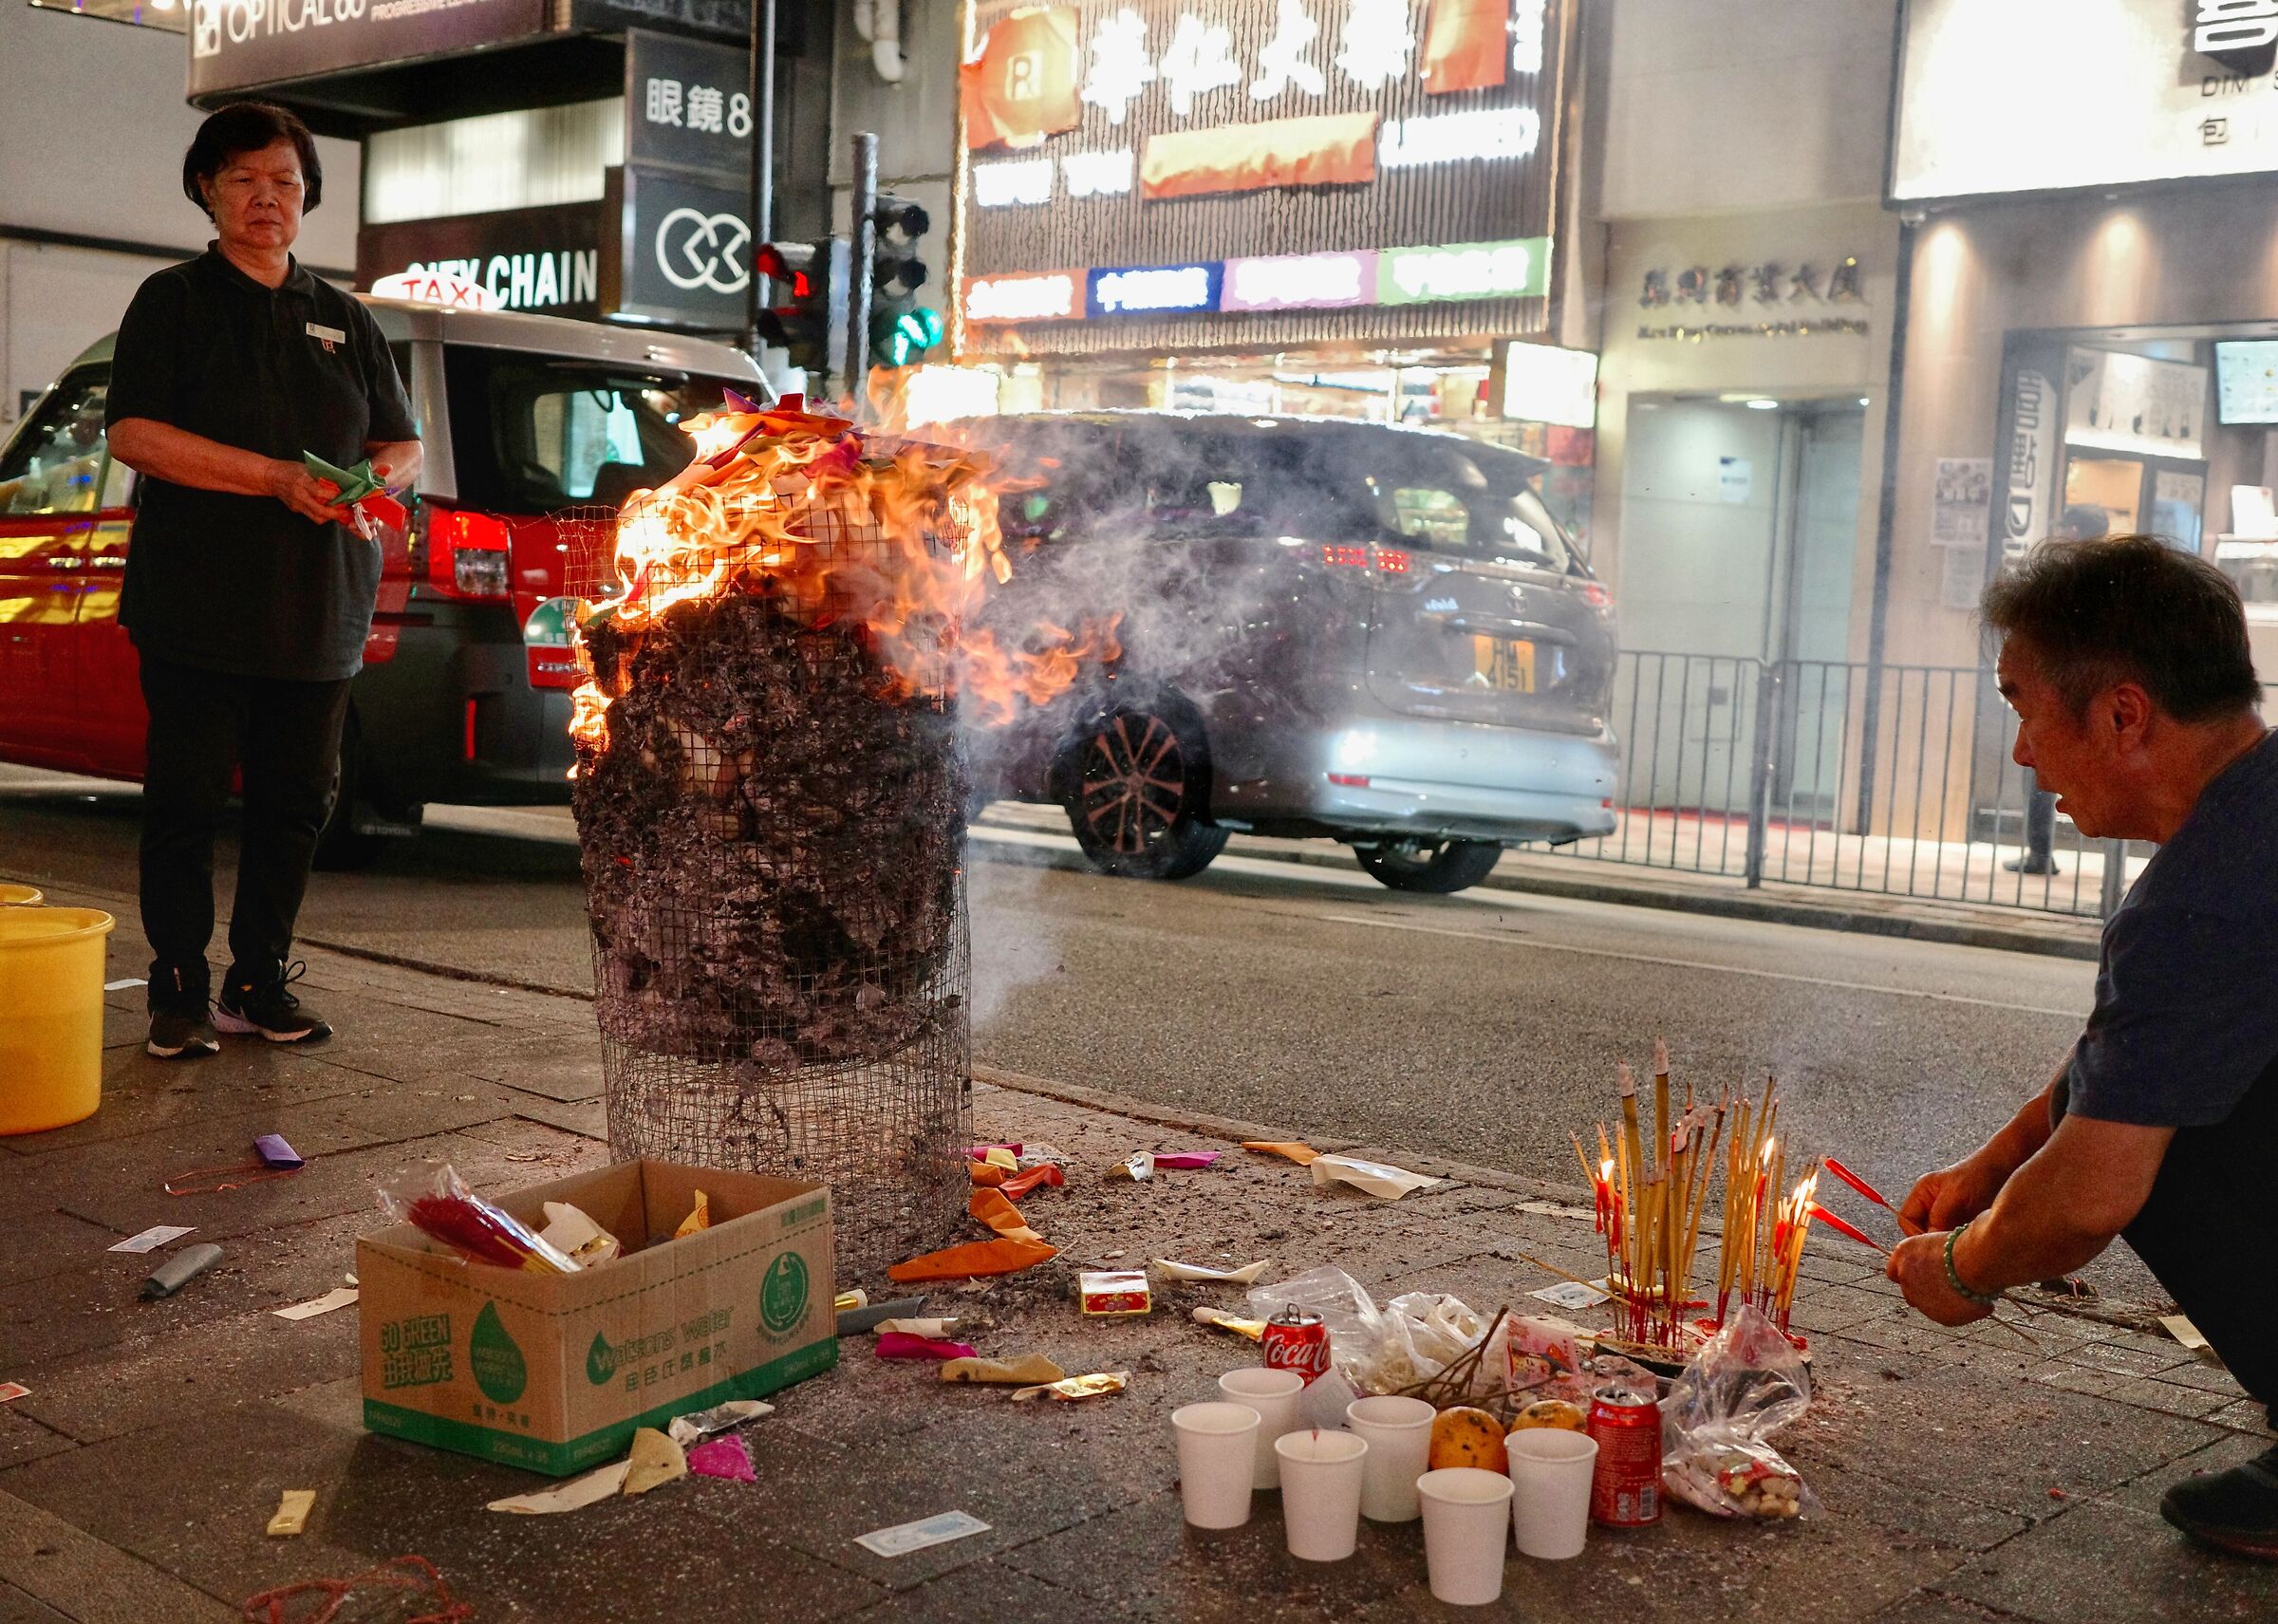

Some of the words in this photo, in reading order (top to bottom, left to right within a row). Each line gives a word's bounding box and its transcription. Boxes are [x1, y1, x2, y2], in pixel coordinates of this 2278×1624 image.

[2201, 73, 2250, 97] DIM
[401, 278, 482, 311] TAXI
[486, 249, 598, 310] CHAIN
[382, 1322, 401, 1353] GO
[402, 1312, 451, 1351] GREEN
[594, 1329, 676, 1372] Watsons
[681, 1306, 734, 1343] Water
